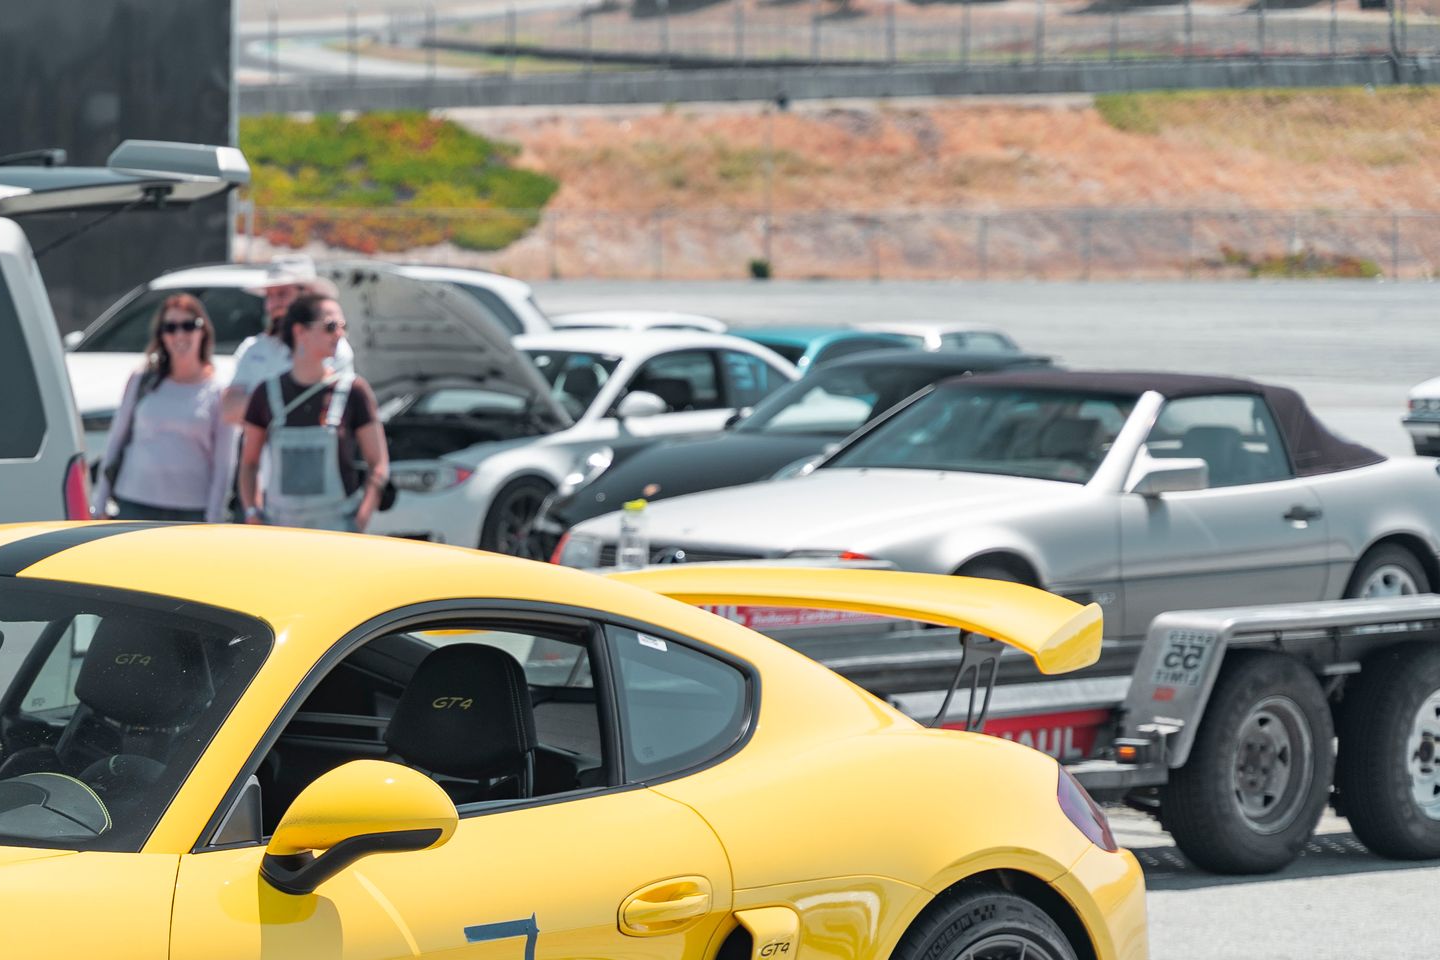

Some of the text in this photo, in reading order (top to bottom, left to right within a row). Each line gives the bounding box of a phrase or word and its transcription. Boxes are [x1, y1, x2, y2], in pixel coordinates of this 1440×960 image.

[115, 653, 152, 666] GT4
[432, 696, 473, 710] GT4
[761, 942, 790, 957] GT4
